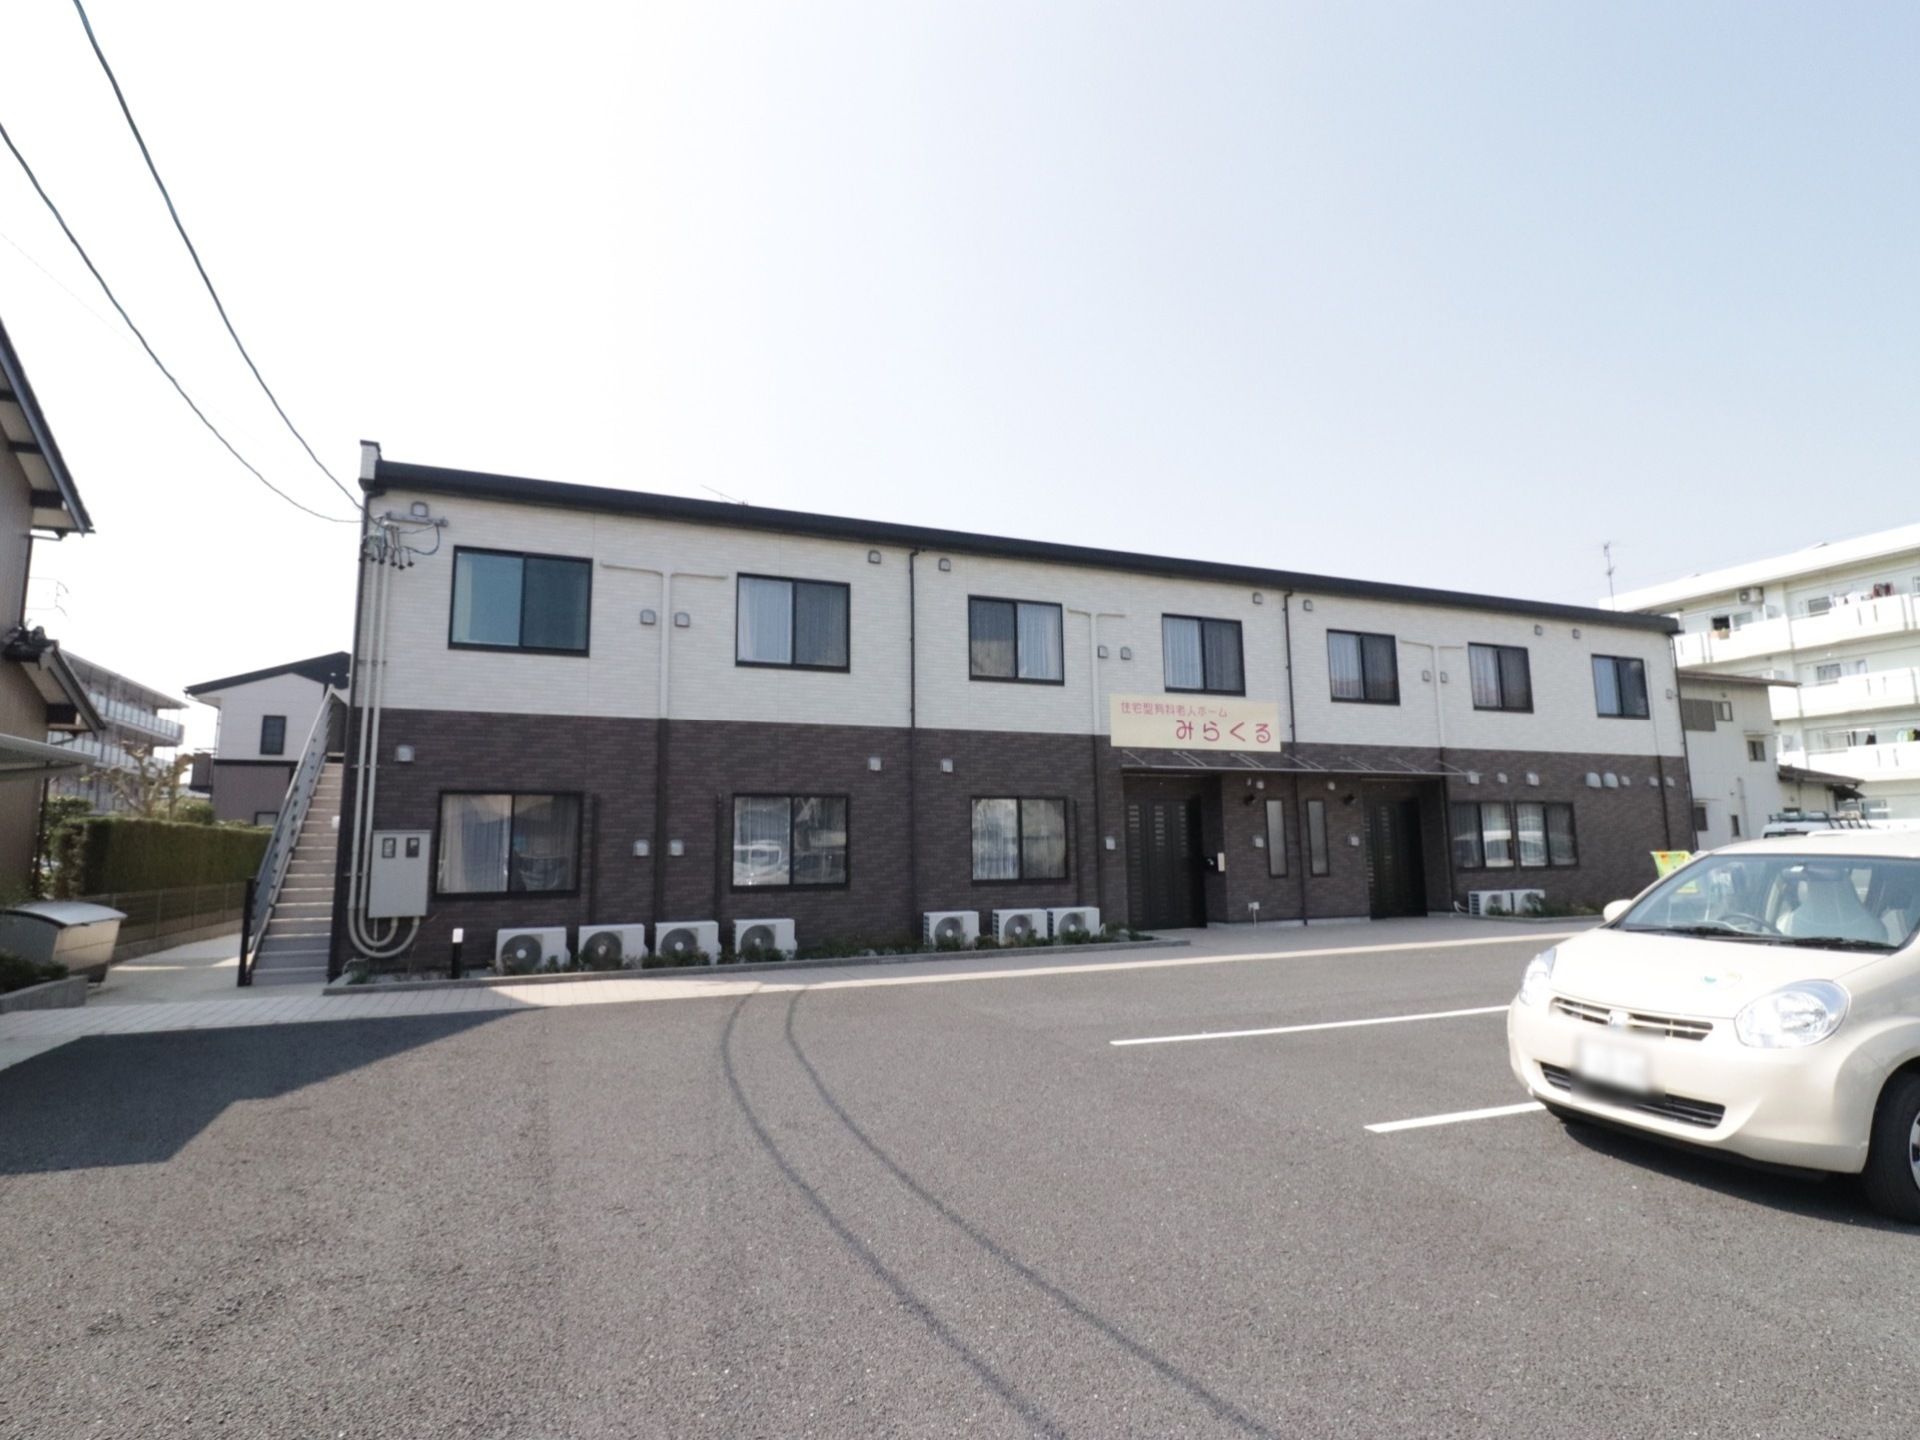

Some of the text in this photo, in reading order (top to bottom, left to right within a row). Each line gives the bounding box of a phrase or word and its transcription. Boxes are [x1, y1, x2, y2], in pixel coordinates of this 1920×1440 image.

[1121, 702, 1228, 718] 住宅型有料老人ホーム
[1175, 719, 1271, 744] みらくる
